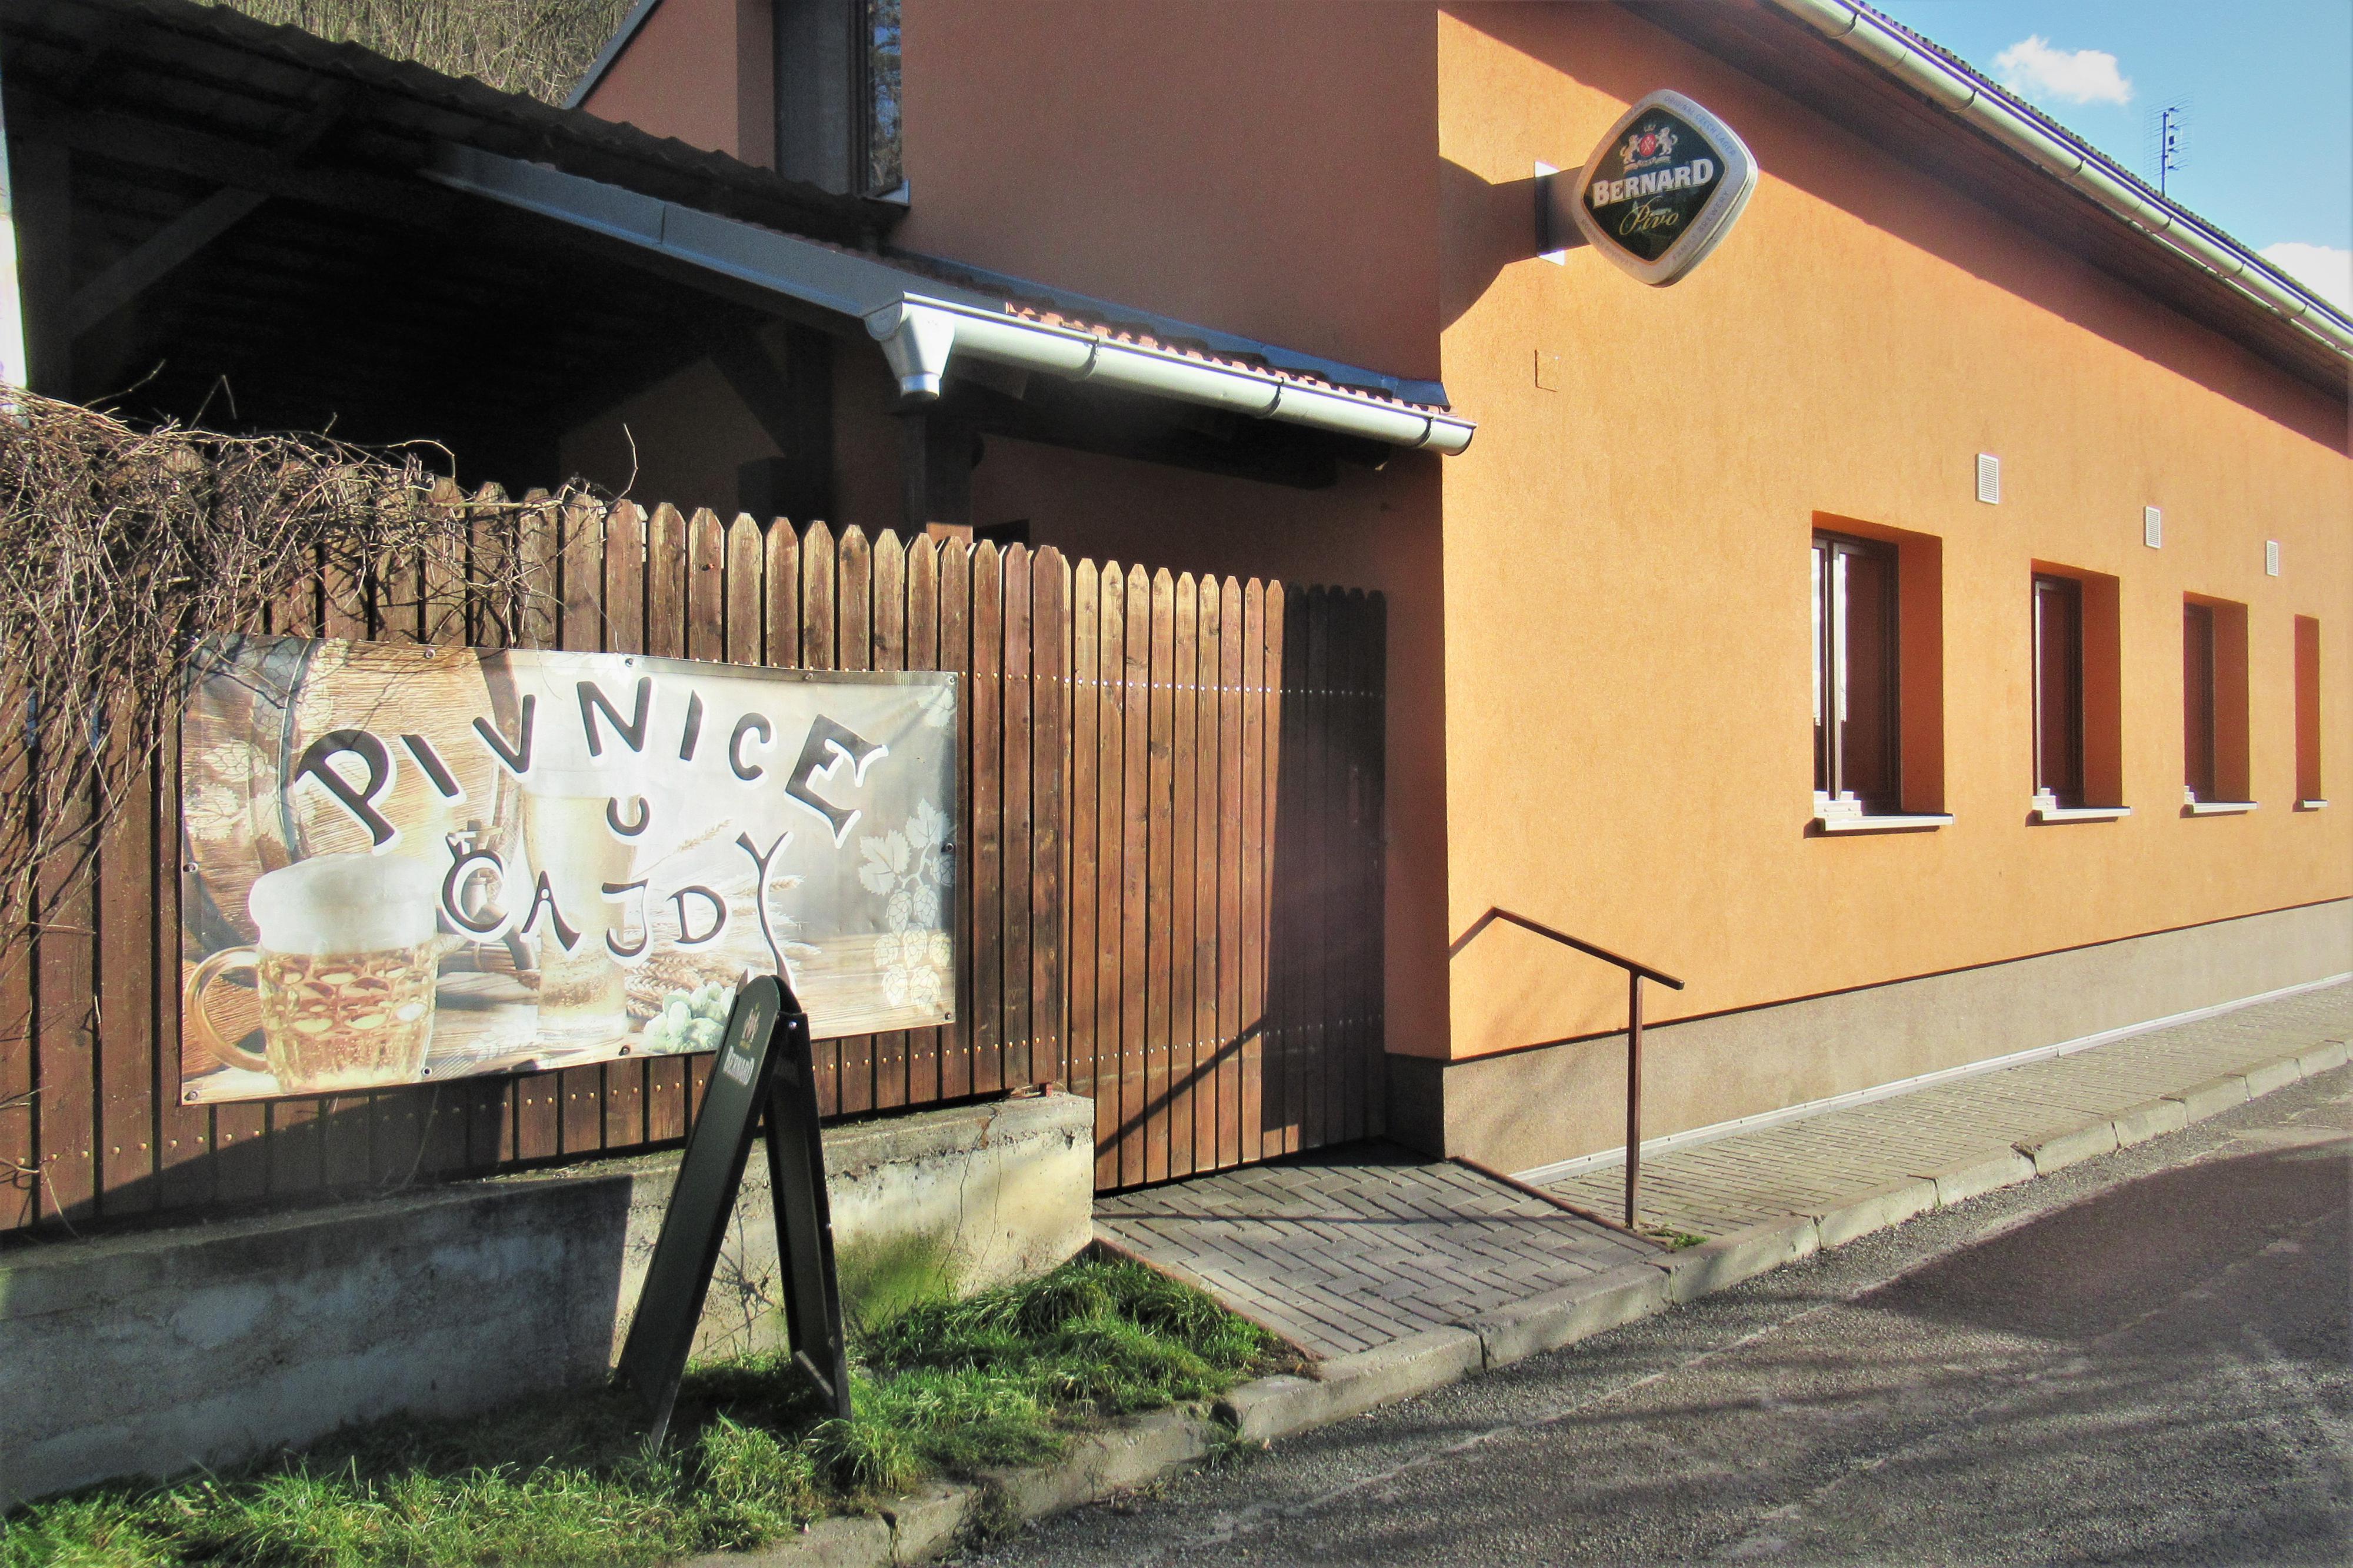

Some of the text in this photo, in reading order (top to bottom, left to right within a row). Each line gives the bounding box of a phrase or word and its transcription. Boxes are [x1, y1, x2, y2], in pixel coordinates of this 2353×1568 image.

[1592, 158, 1714, 209] BERNARD
[1619, 195, 1679, 235] Pivo
[294, 676, 888, 851] PIVNICE
[606, 796, 651, 839] U
[441, 830, 792, 994] ČAJDY
